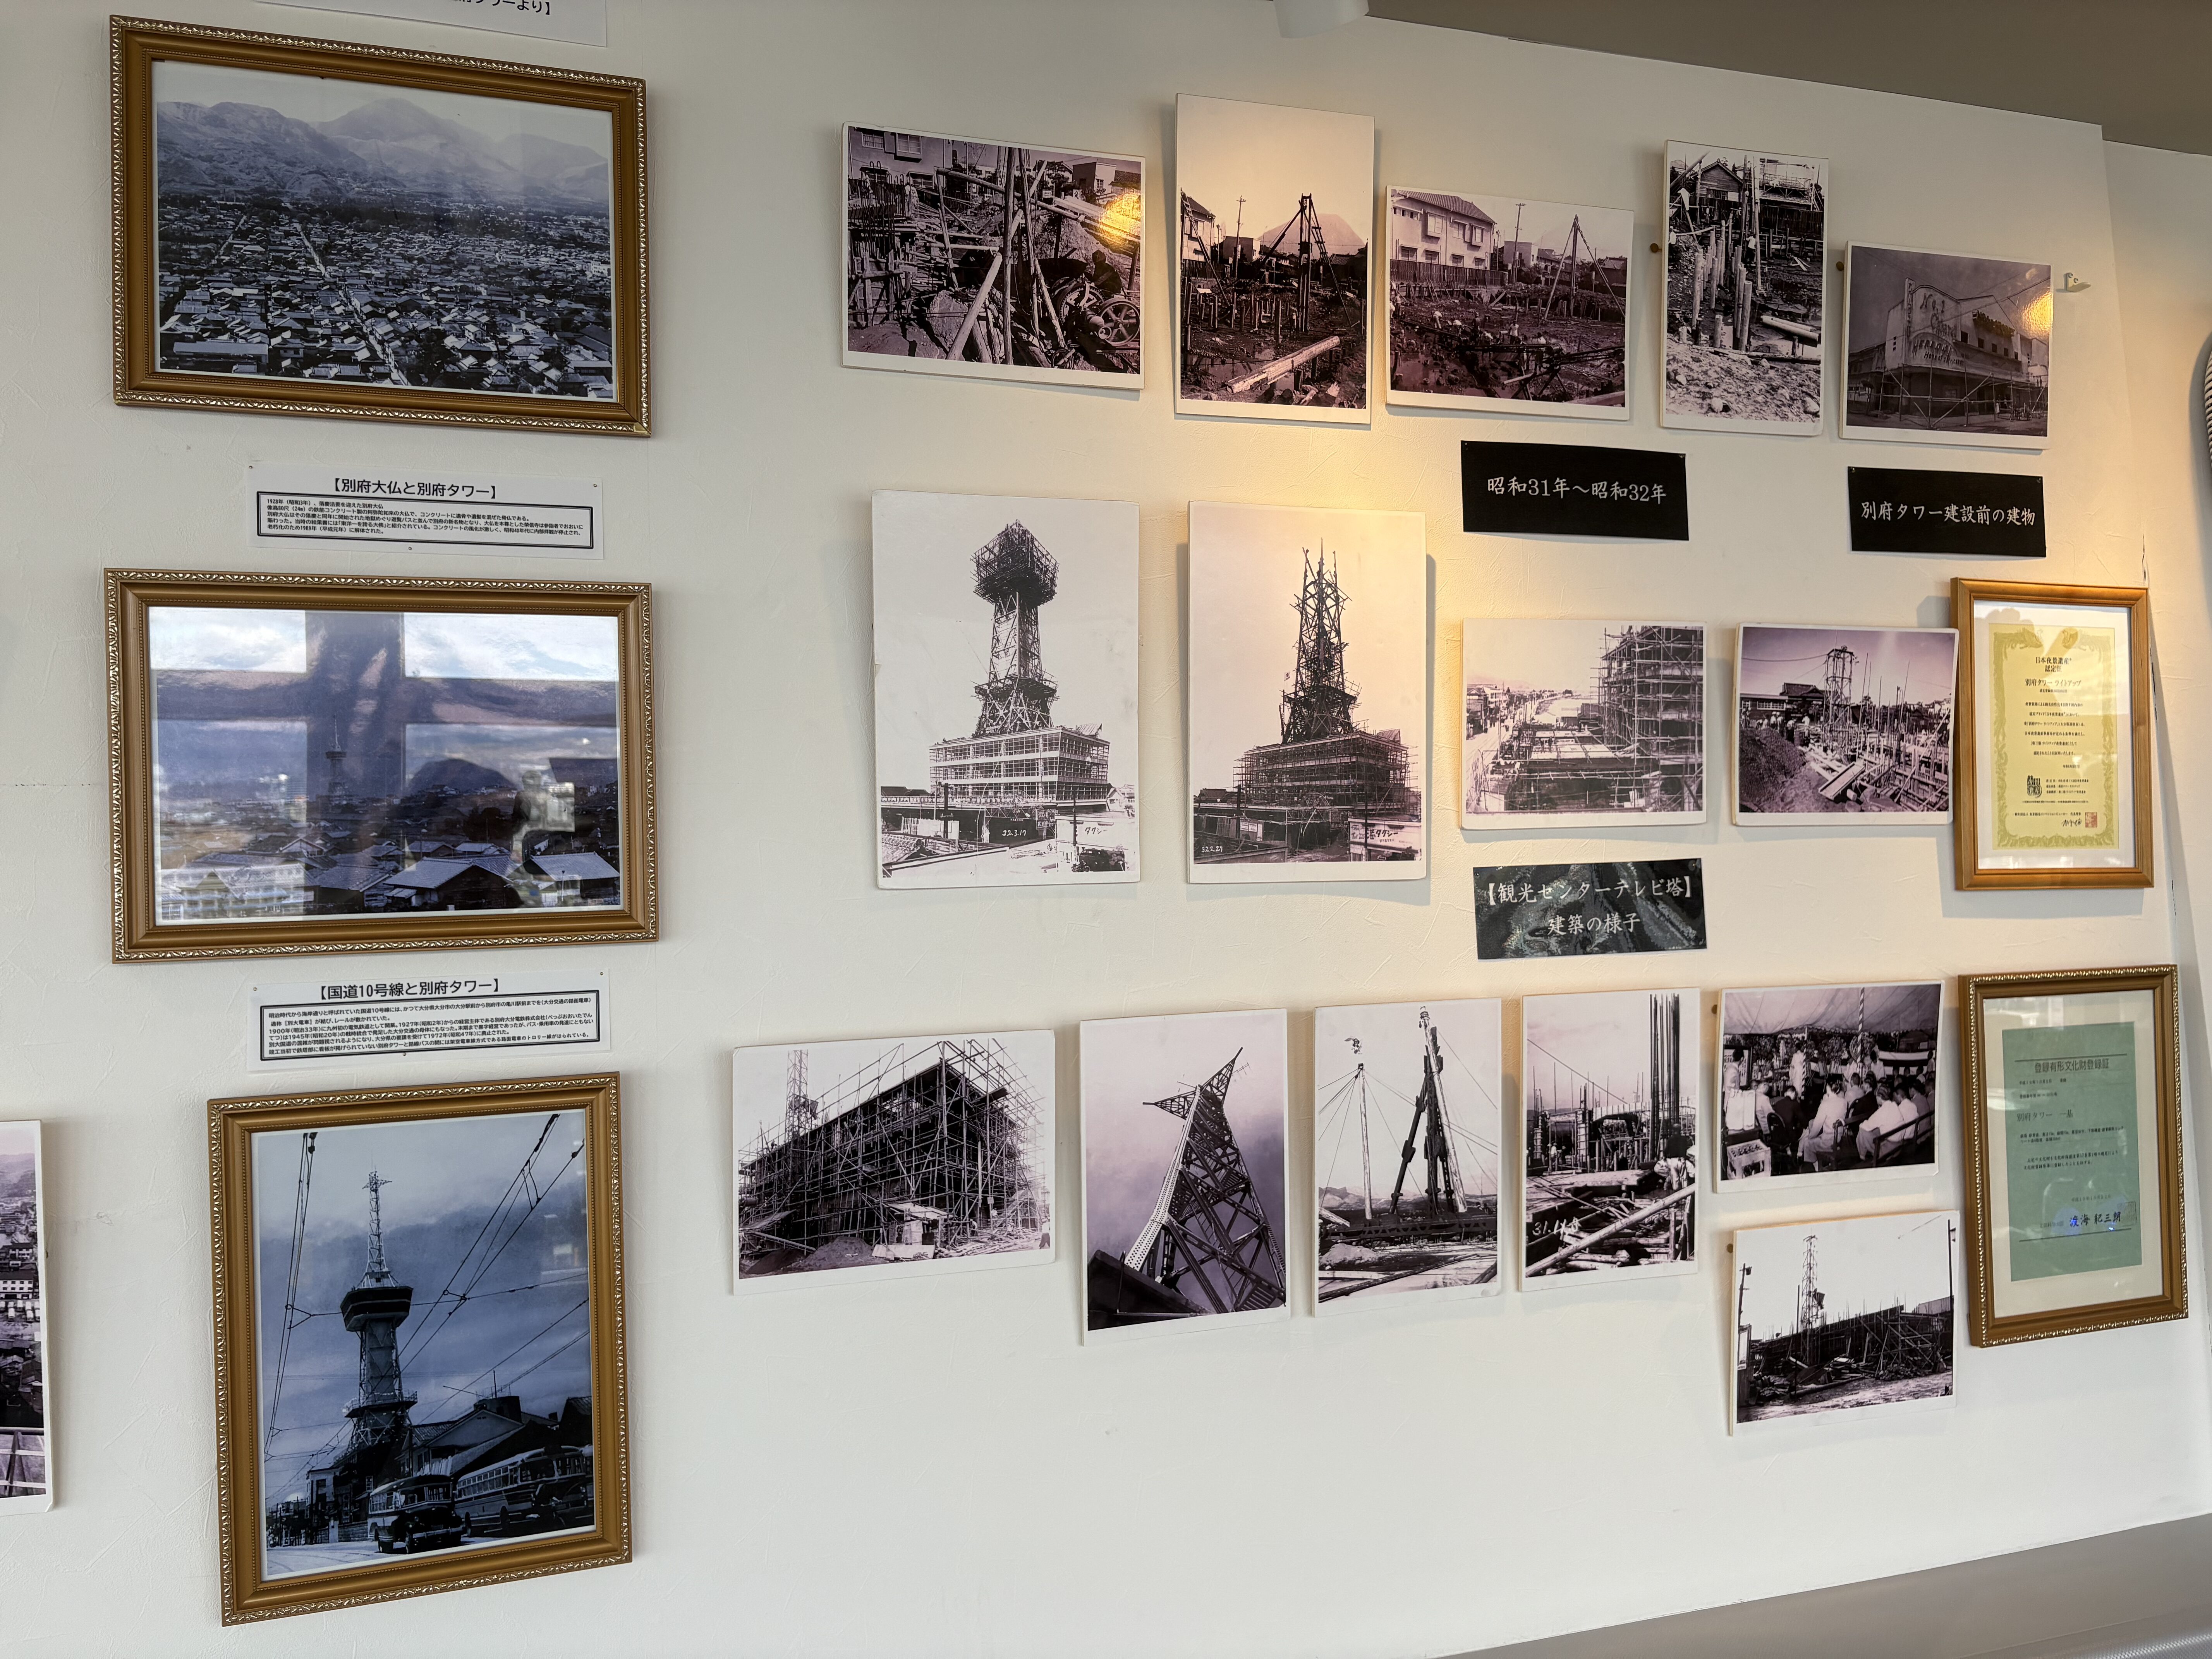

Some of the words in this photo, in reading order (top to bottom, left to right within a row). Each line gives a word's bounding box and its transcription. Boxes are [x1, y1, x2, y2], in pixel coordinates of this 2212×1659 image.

[335, 477, 496, 499] 【別府大仏と別府タワー】
[1861, 501, 2035, 526] 別府タワー建設前の建物
[1489, 876, 1692, 905] 【観光センターテレビ塔】
[1547, 912, 1640, 936] 建築の様子
[321, 978, 499, 1000] 【国道10号線と別府タワー】
